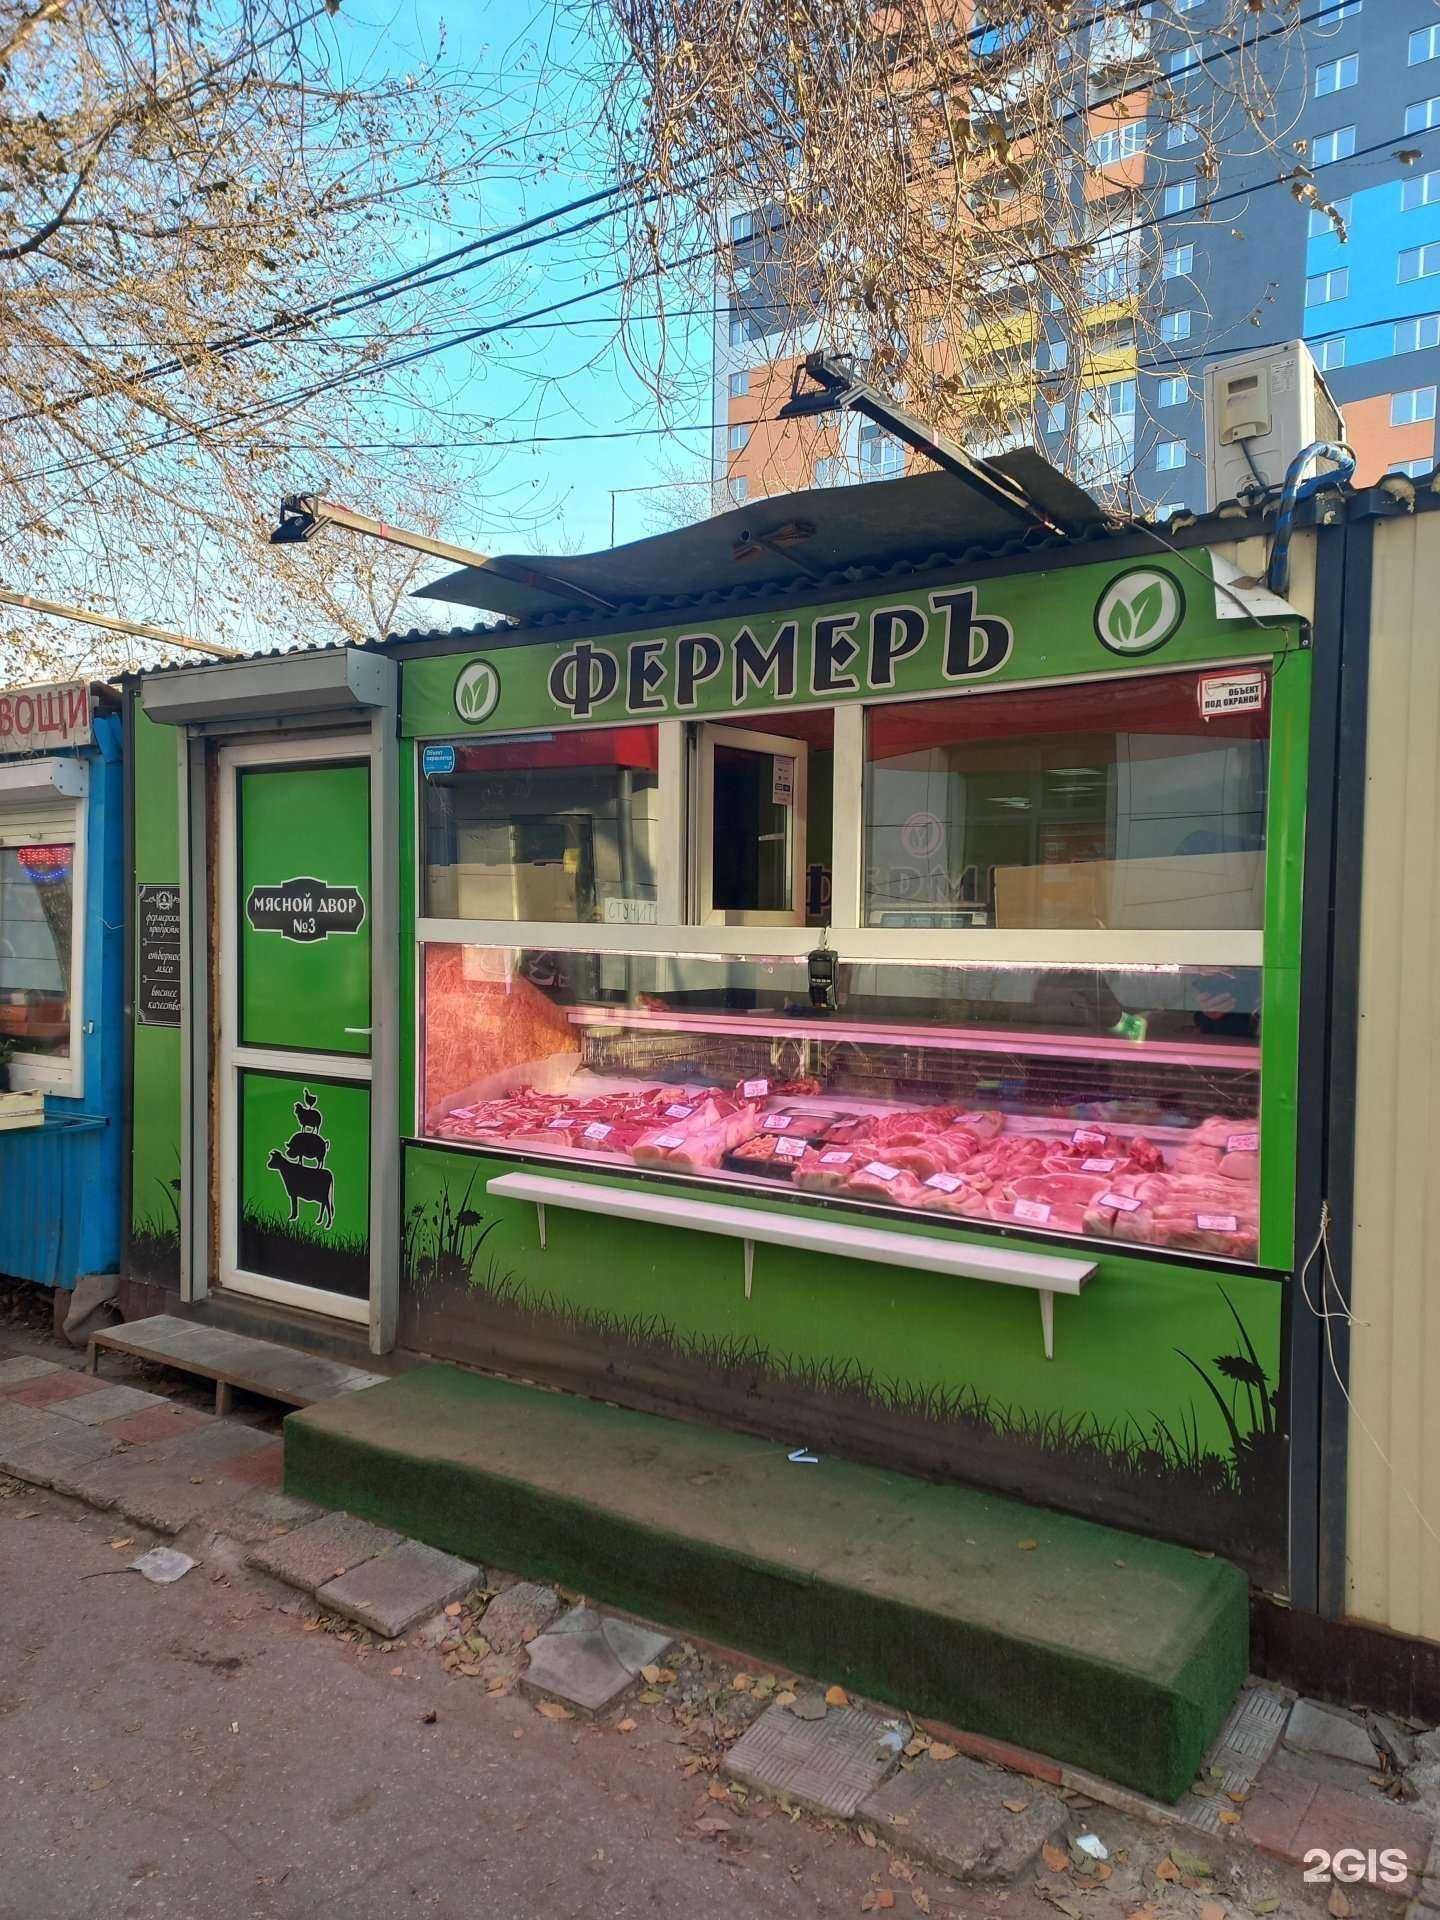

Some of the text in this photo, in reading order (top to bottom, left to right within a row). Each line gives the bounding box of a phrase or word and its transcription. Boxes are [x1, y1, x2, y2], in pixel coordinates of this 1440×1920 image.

[548, 586, 1014, 718] ФЕРМЕРЪ
[1228, 685, 1259, 696] ОБЪЕКТ
[1204, 694, 1260, 709] ПОД ОХРАНОЙ
[254, 892, 357, 913] МЯСНОЙ ДВОР
[293, 917, 316, 934] №3
